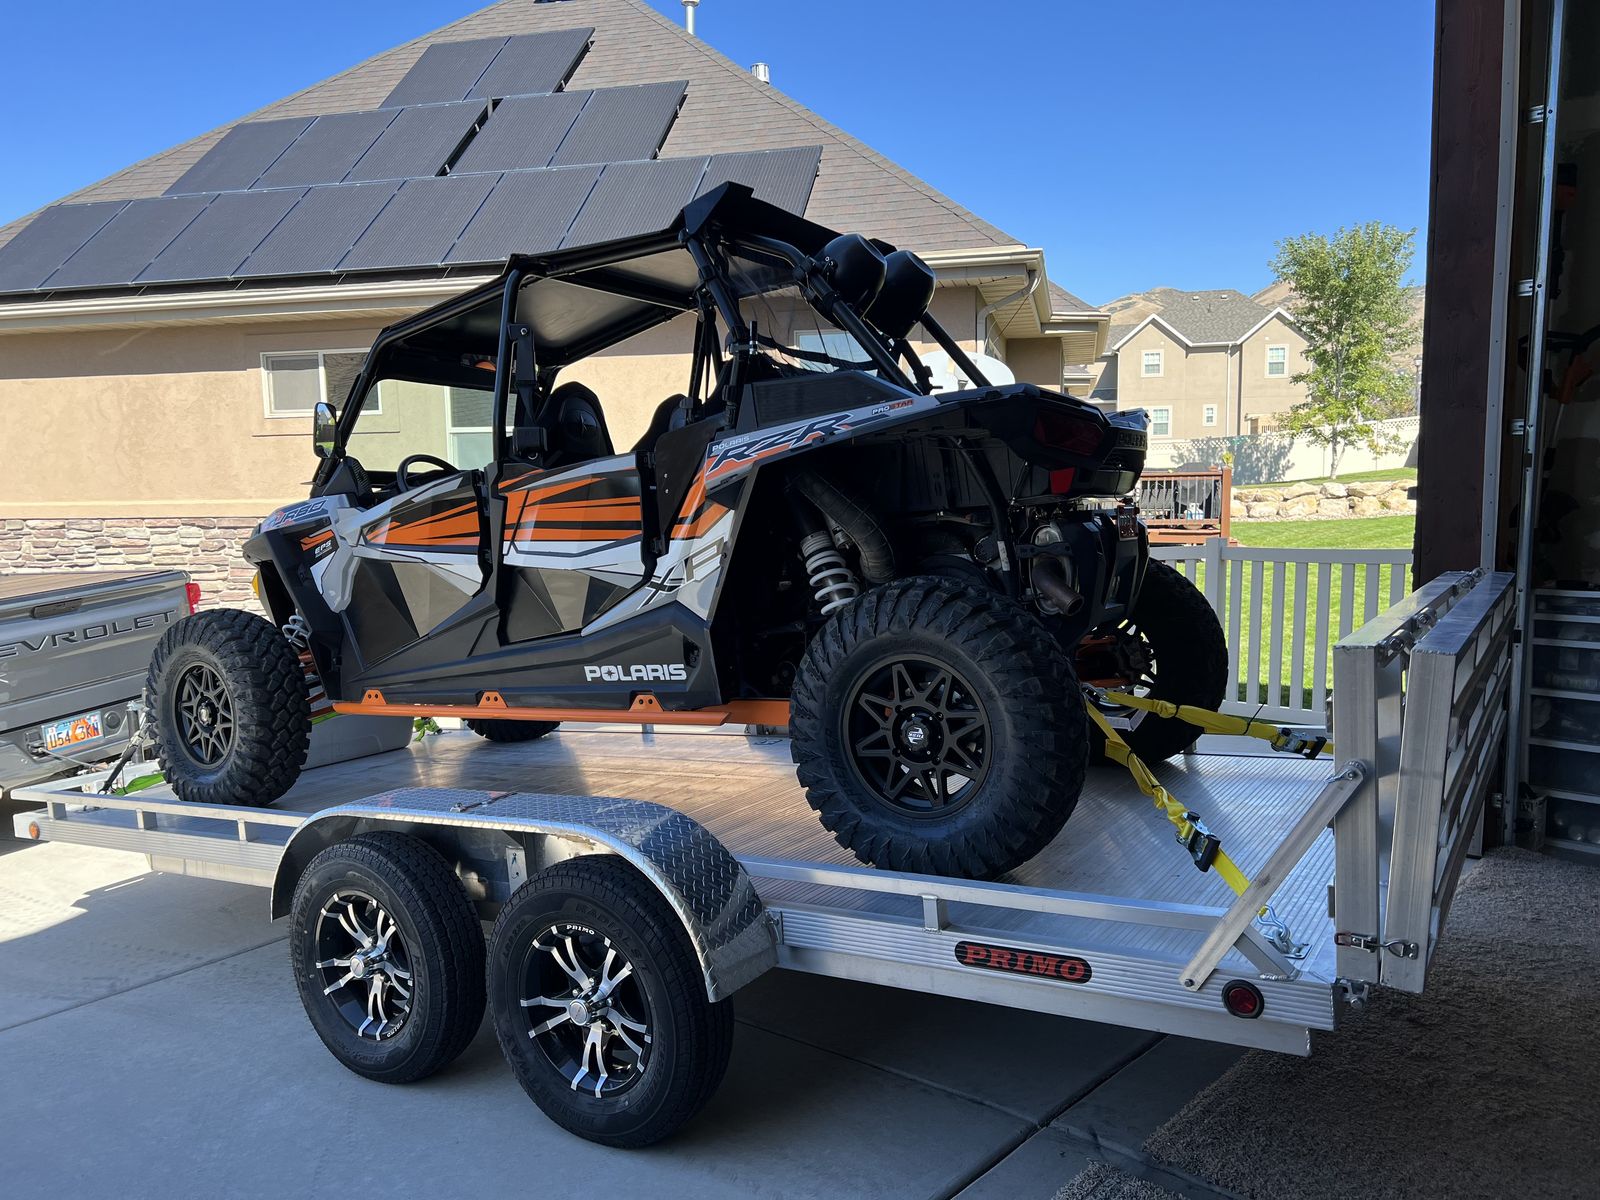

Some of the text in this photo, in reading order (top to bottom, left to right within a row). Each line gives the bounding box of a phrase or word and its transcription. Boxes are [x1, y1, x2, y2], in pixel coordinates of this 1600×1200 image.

[706, 413, 854, 476] RZR
[712, 435, 749, 452] POLARIS
[315, 539, 332, 555] EPS
[583, 663, 687, 682] POLARIS
[566, 924, 595, 935] PRIMO
[962, 944, 1085, 980] PRIMO
